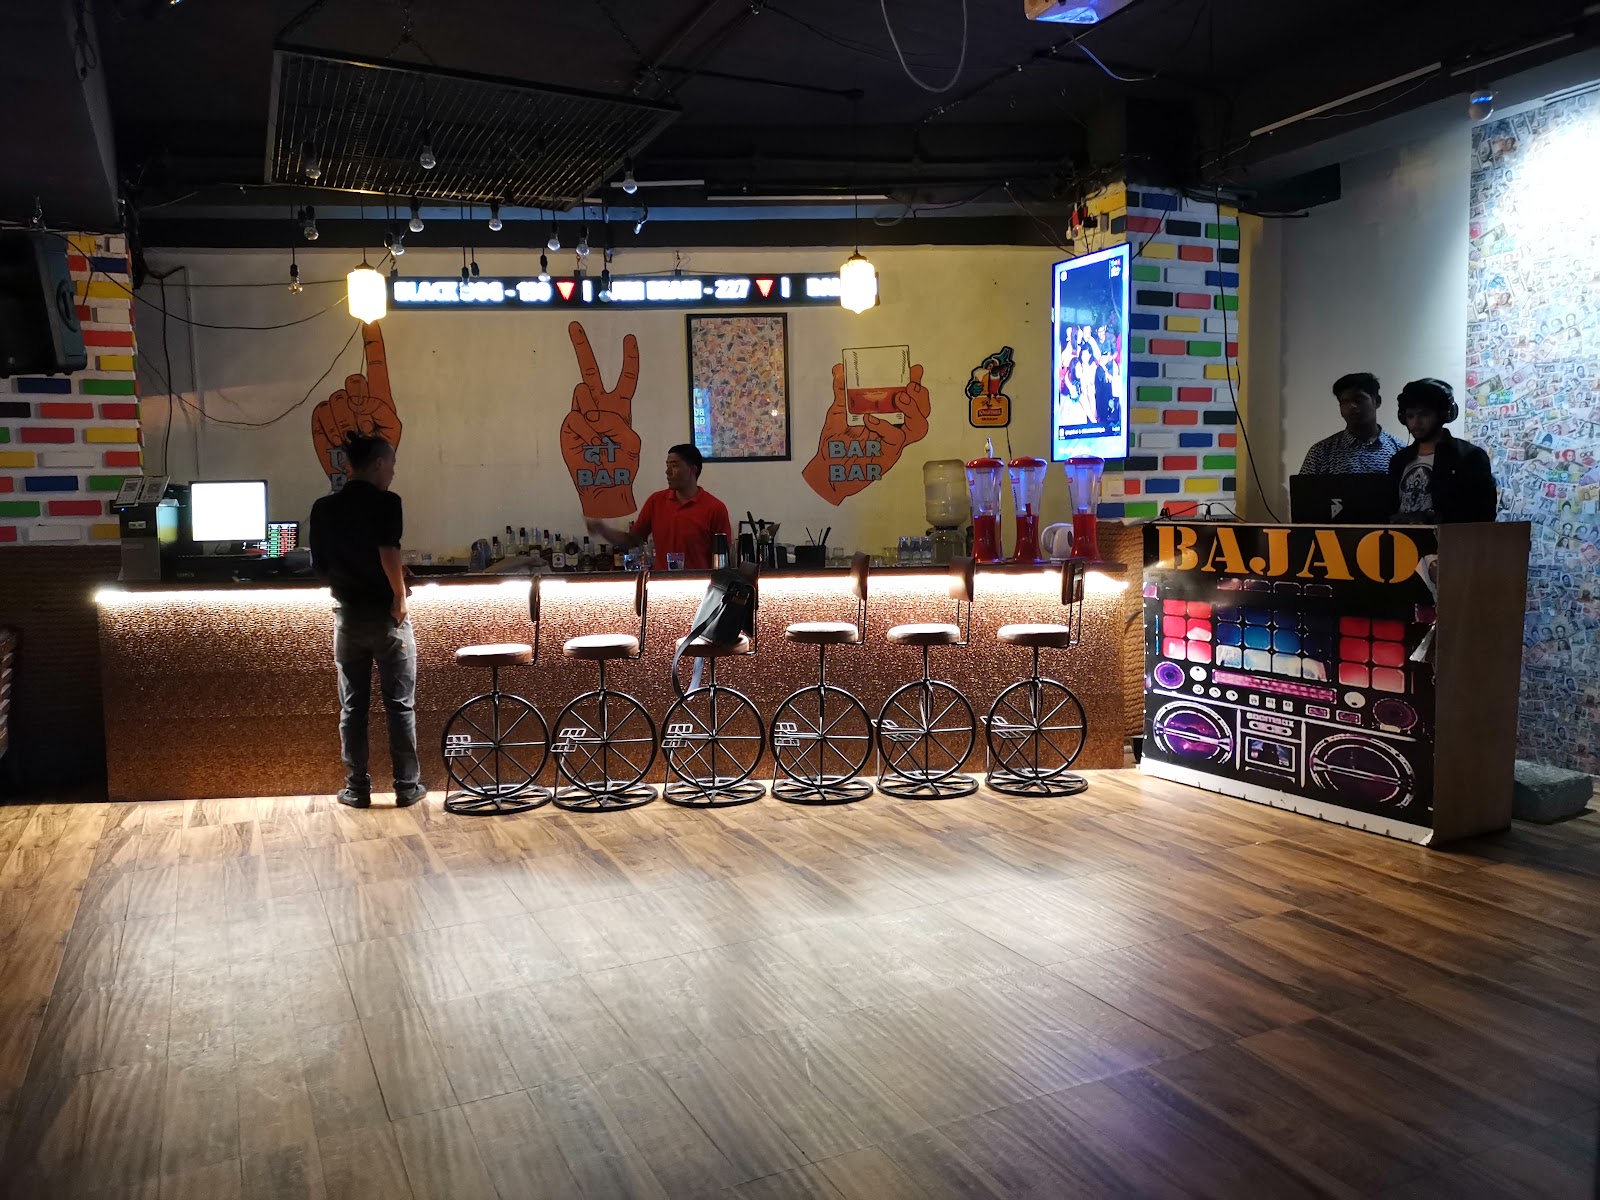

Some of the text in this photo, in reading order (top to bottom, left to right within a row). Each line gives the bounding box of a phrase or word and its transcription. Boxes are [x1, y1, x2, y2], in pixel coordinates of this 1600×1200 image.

[828, 440, 882, 458] BAR
[576, 468, 631, 487] BAR
[828, 464, 883, 482] BAR
[1154, 525, 1419, 584] BAJAO
